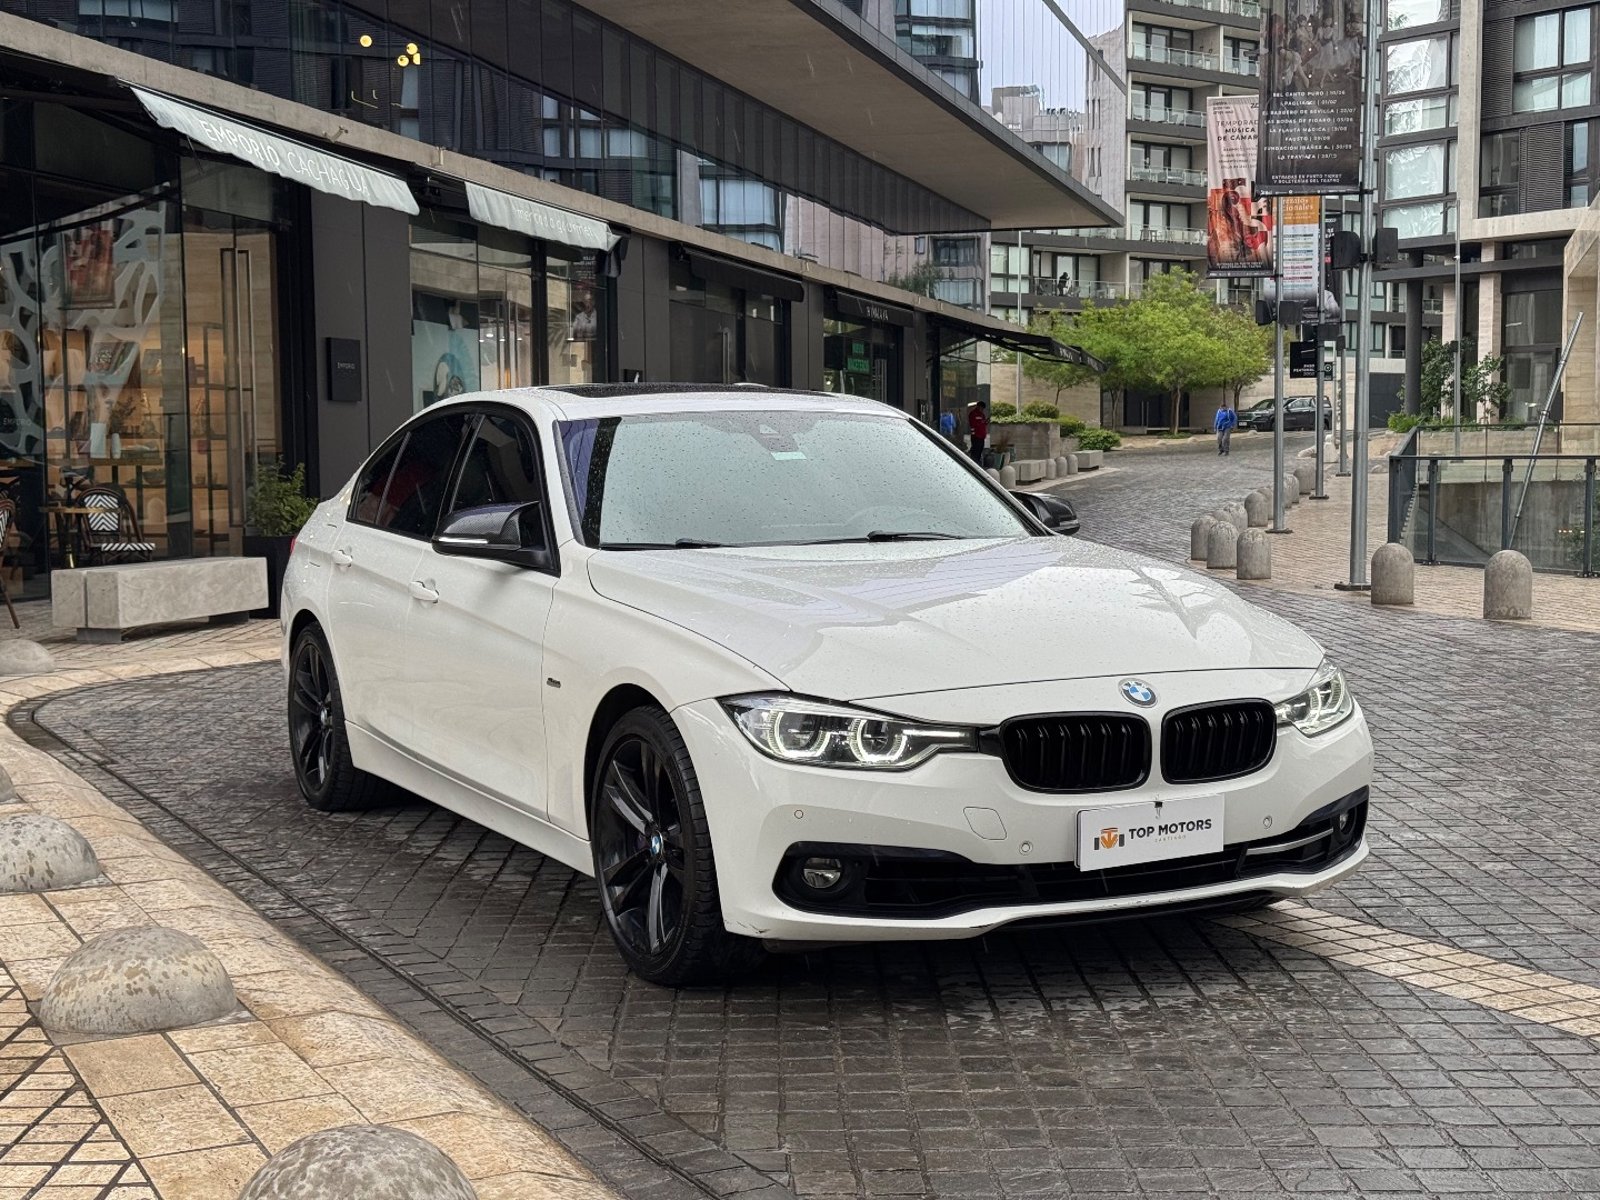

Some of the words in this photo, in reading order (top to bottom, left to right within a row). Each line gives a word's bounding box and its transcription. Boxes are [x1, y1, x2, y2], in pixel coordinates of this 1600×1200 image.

[199, 119, 281, 167] EMPORIO
[287, 151, 371, 198] CACHAGUA
[1128, 826, 1155, 840] TOP
[1158, 818, 1212, 836] MOTORS
